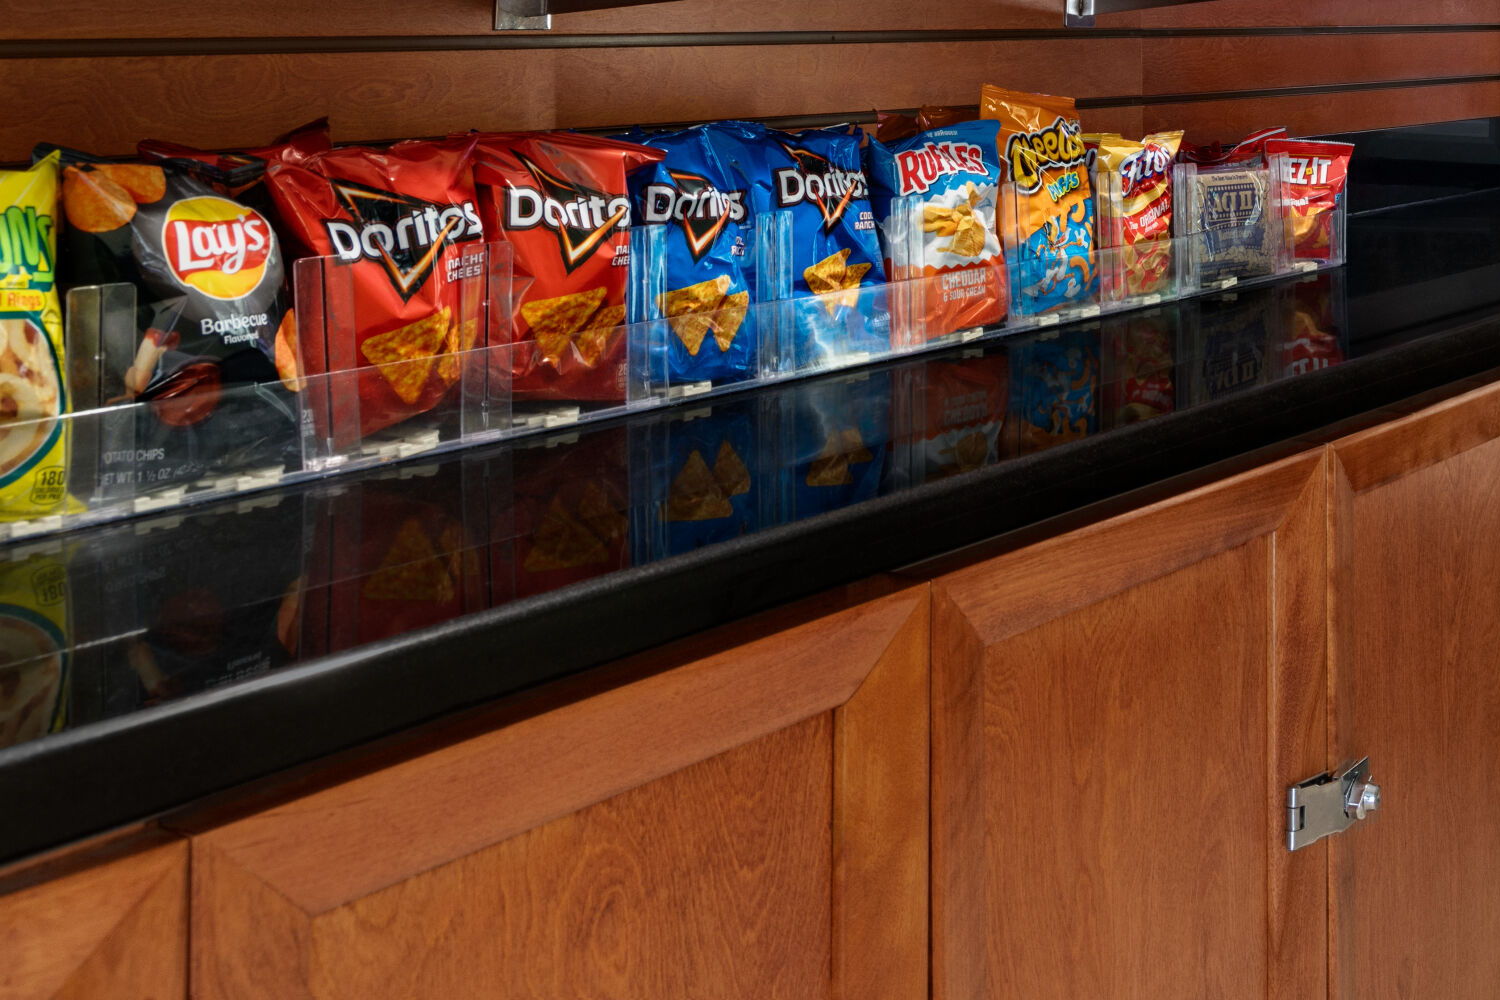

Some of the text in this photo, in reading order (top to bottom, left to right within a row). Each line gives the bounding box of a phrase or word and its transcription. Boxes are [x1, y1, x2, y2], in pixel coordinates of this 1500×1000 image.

[898, 143, 988, 195] RUFFLES
[508, 186, 631, 230] Dorito
[645, 184, 746, 223] Doritos
[1139, 197, 1170, 227] ORIGINAL
[174, 213, 265, 275] Lay's
[326, 201, 484, 263] Doritos
[941, 268, 987, 290] CHEDDAR
[200, 312, 268, 336] Barbecue
[104, 447, 165, 465] OTATO CHIPS
